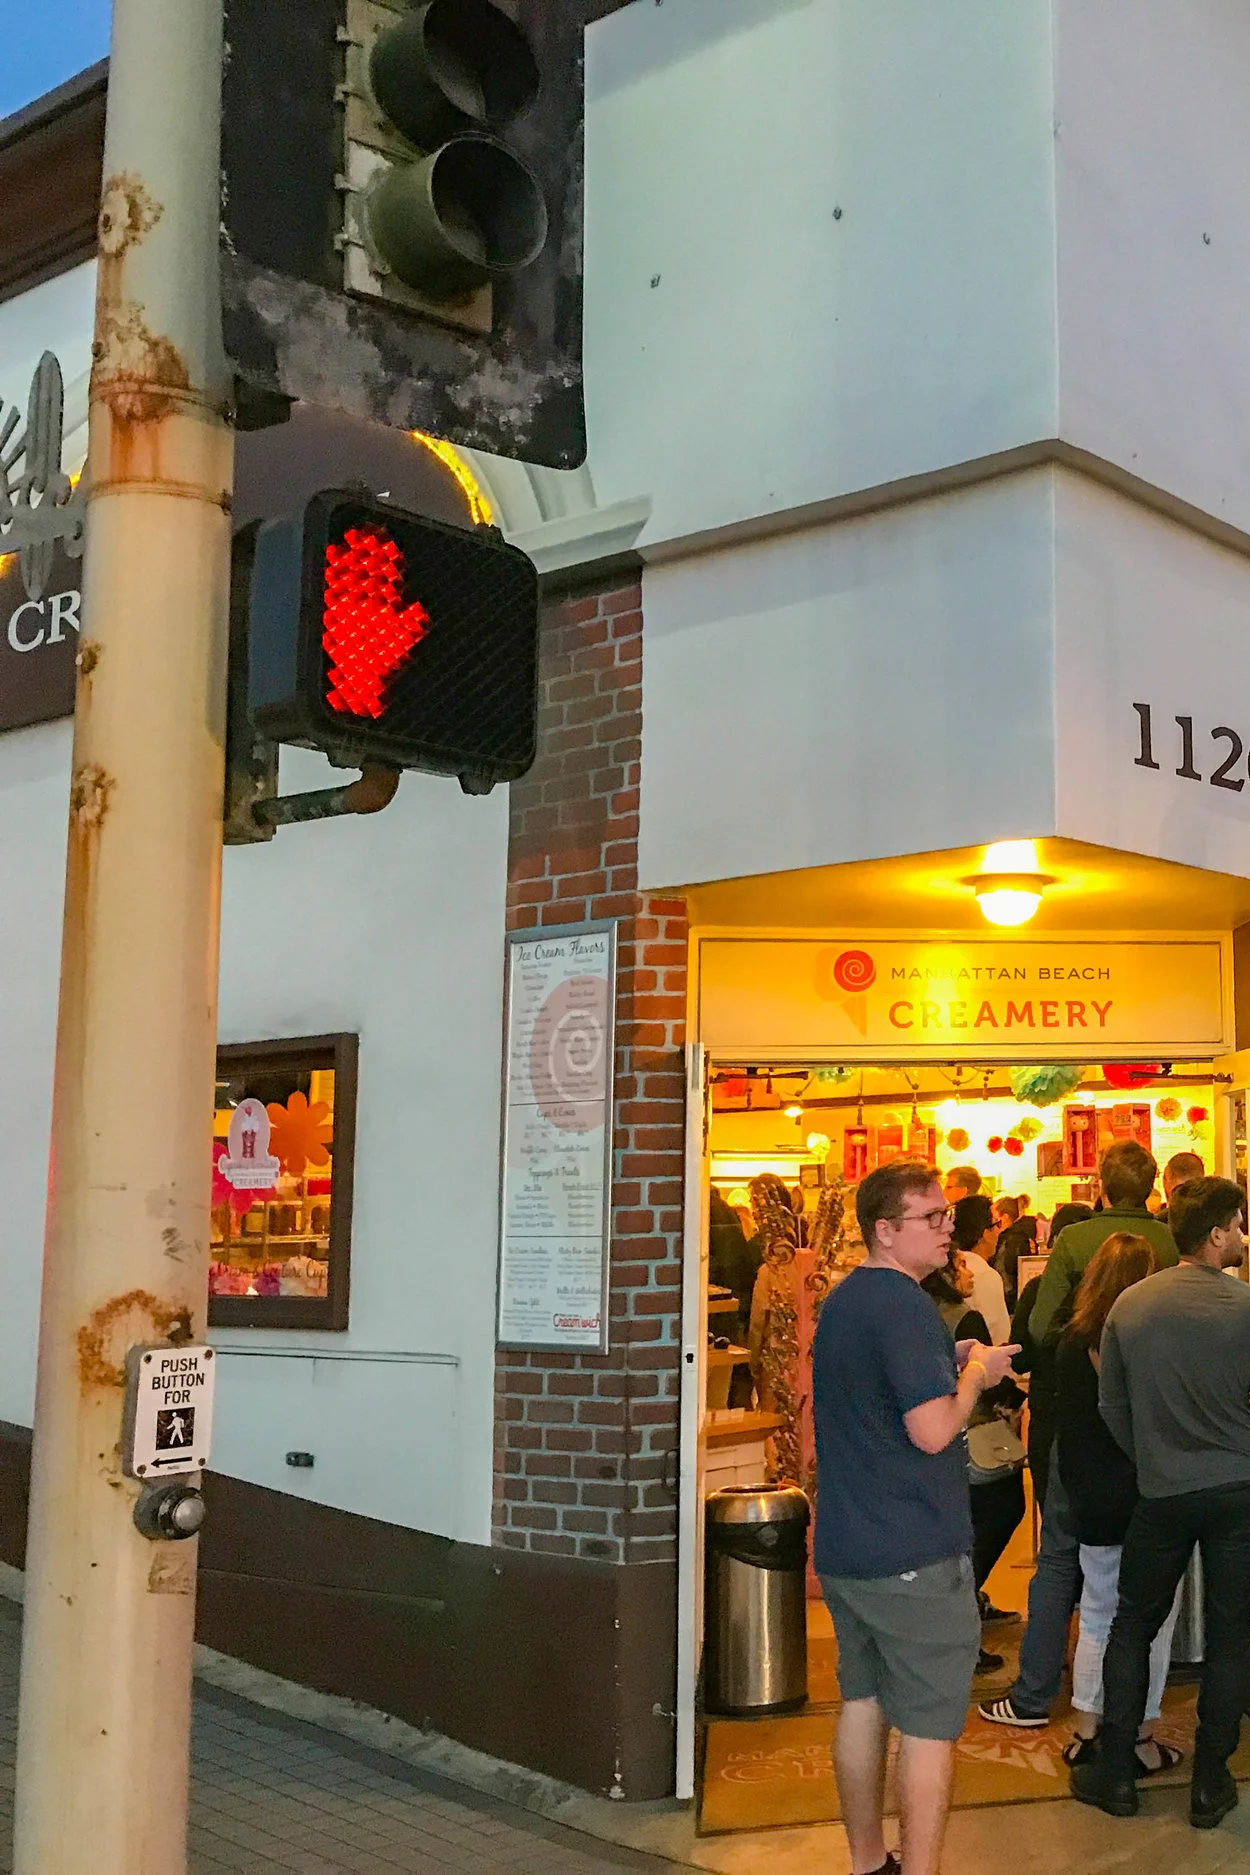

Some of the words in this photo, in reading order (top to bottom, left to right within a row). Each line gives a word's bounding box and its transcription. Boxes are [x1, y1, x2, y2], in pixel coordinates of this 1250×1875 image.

[517, 945, 531, 961] Ice
[535, 944, 565, 960] Cream
[569, 938, 605, 957] Flavors
[891, 967, 1027, 980] MANHATTAN
[1039, 967, 1110, 980] BEACH
[888, 1000, 1113, 1029] CREAMERY
[161, 1357, 198, 1373] PUSH
[152, 1372, 205, 1390] BUTTON
[164, 1390, 191, 1405] FOR
